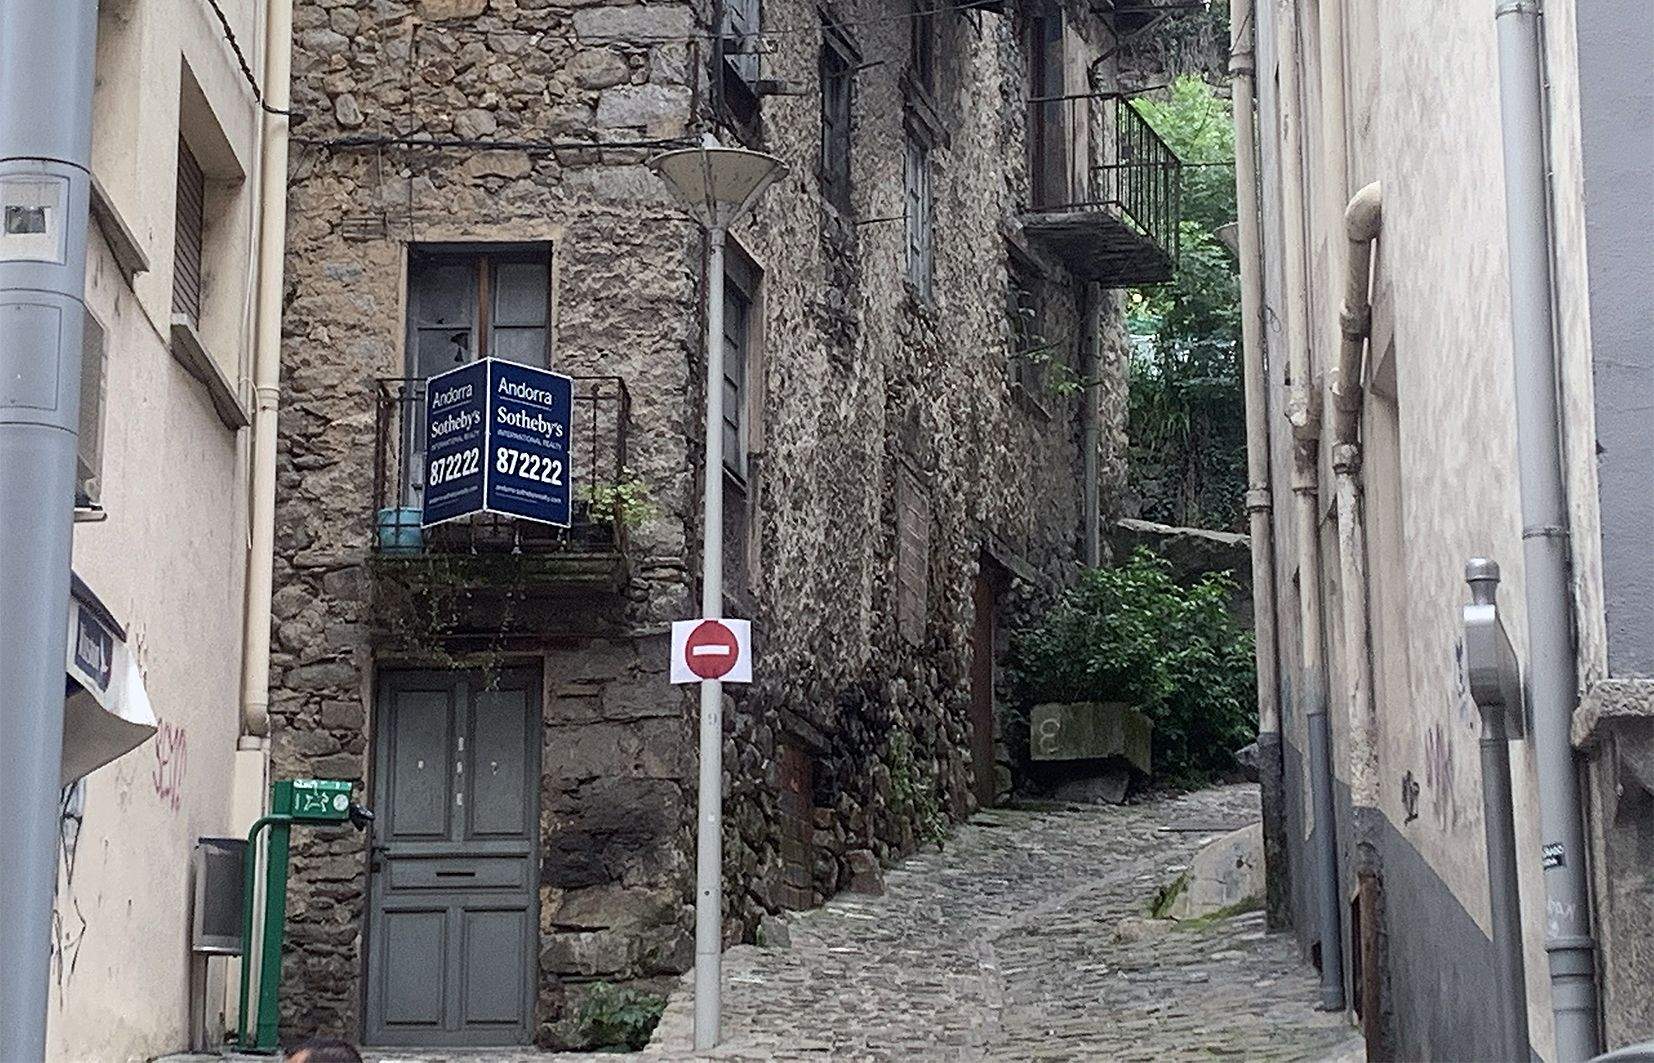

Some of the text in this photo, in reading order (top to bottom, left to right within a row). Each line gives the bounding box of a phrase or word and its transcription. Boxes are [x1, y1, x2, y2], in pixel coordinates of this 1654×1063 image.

[432, 383, 473, 408] Andorra
[498, 377, 552, 405] Andorra
[431, 409, 481, 438] Sotheby's
[497, 406, 563, 438] Sotheby's
